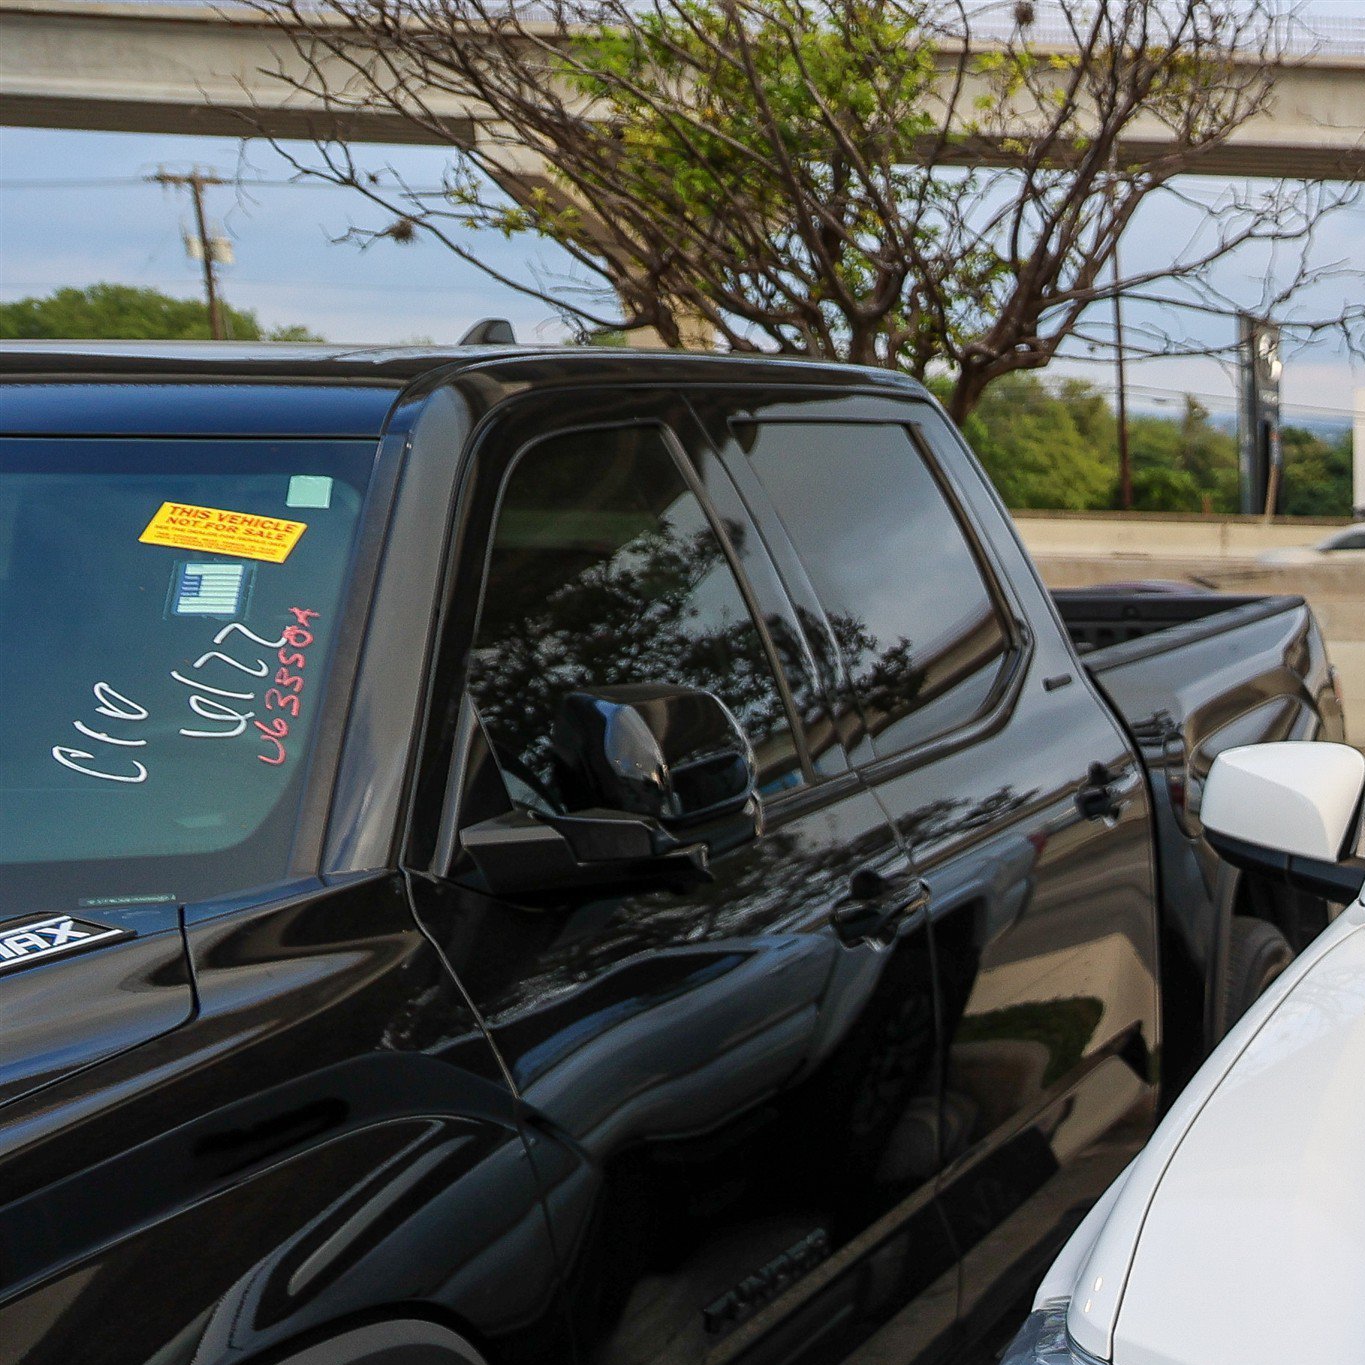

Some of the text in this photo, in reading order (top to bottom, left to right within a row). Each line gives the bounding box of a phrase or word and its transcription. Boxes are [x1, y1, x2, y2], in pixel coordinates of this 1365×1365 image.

[166, 516, 200, 528] NOT
[204, 521, 239, 534] FOR
[244, 527, 288, 541] SALE
[168, 505, 297, 534] THIS VEHICLE
